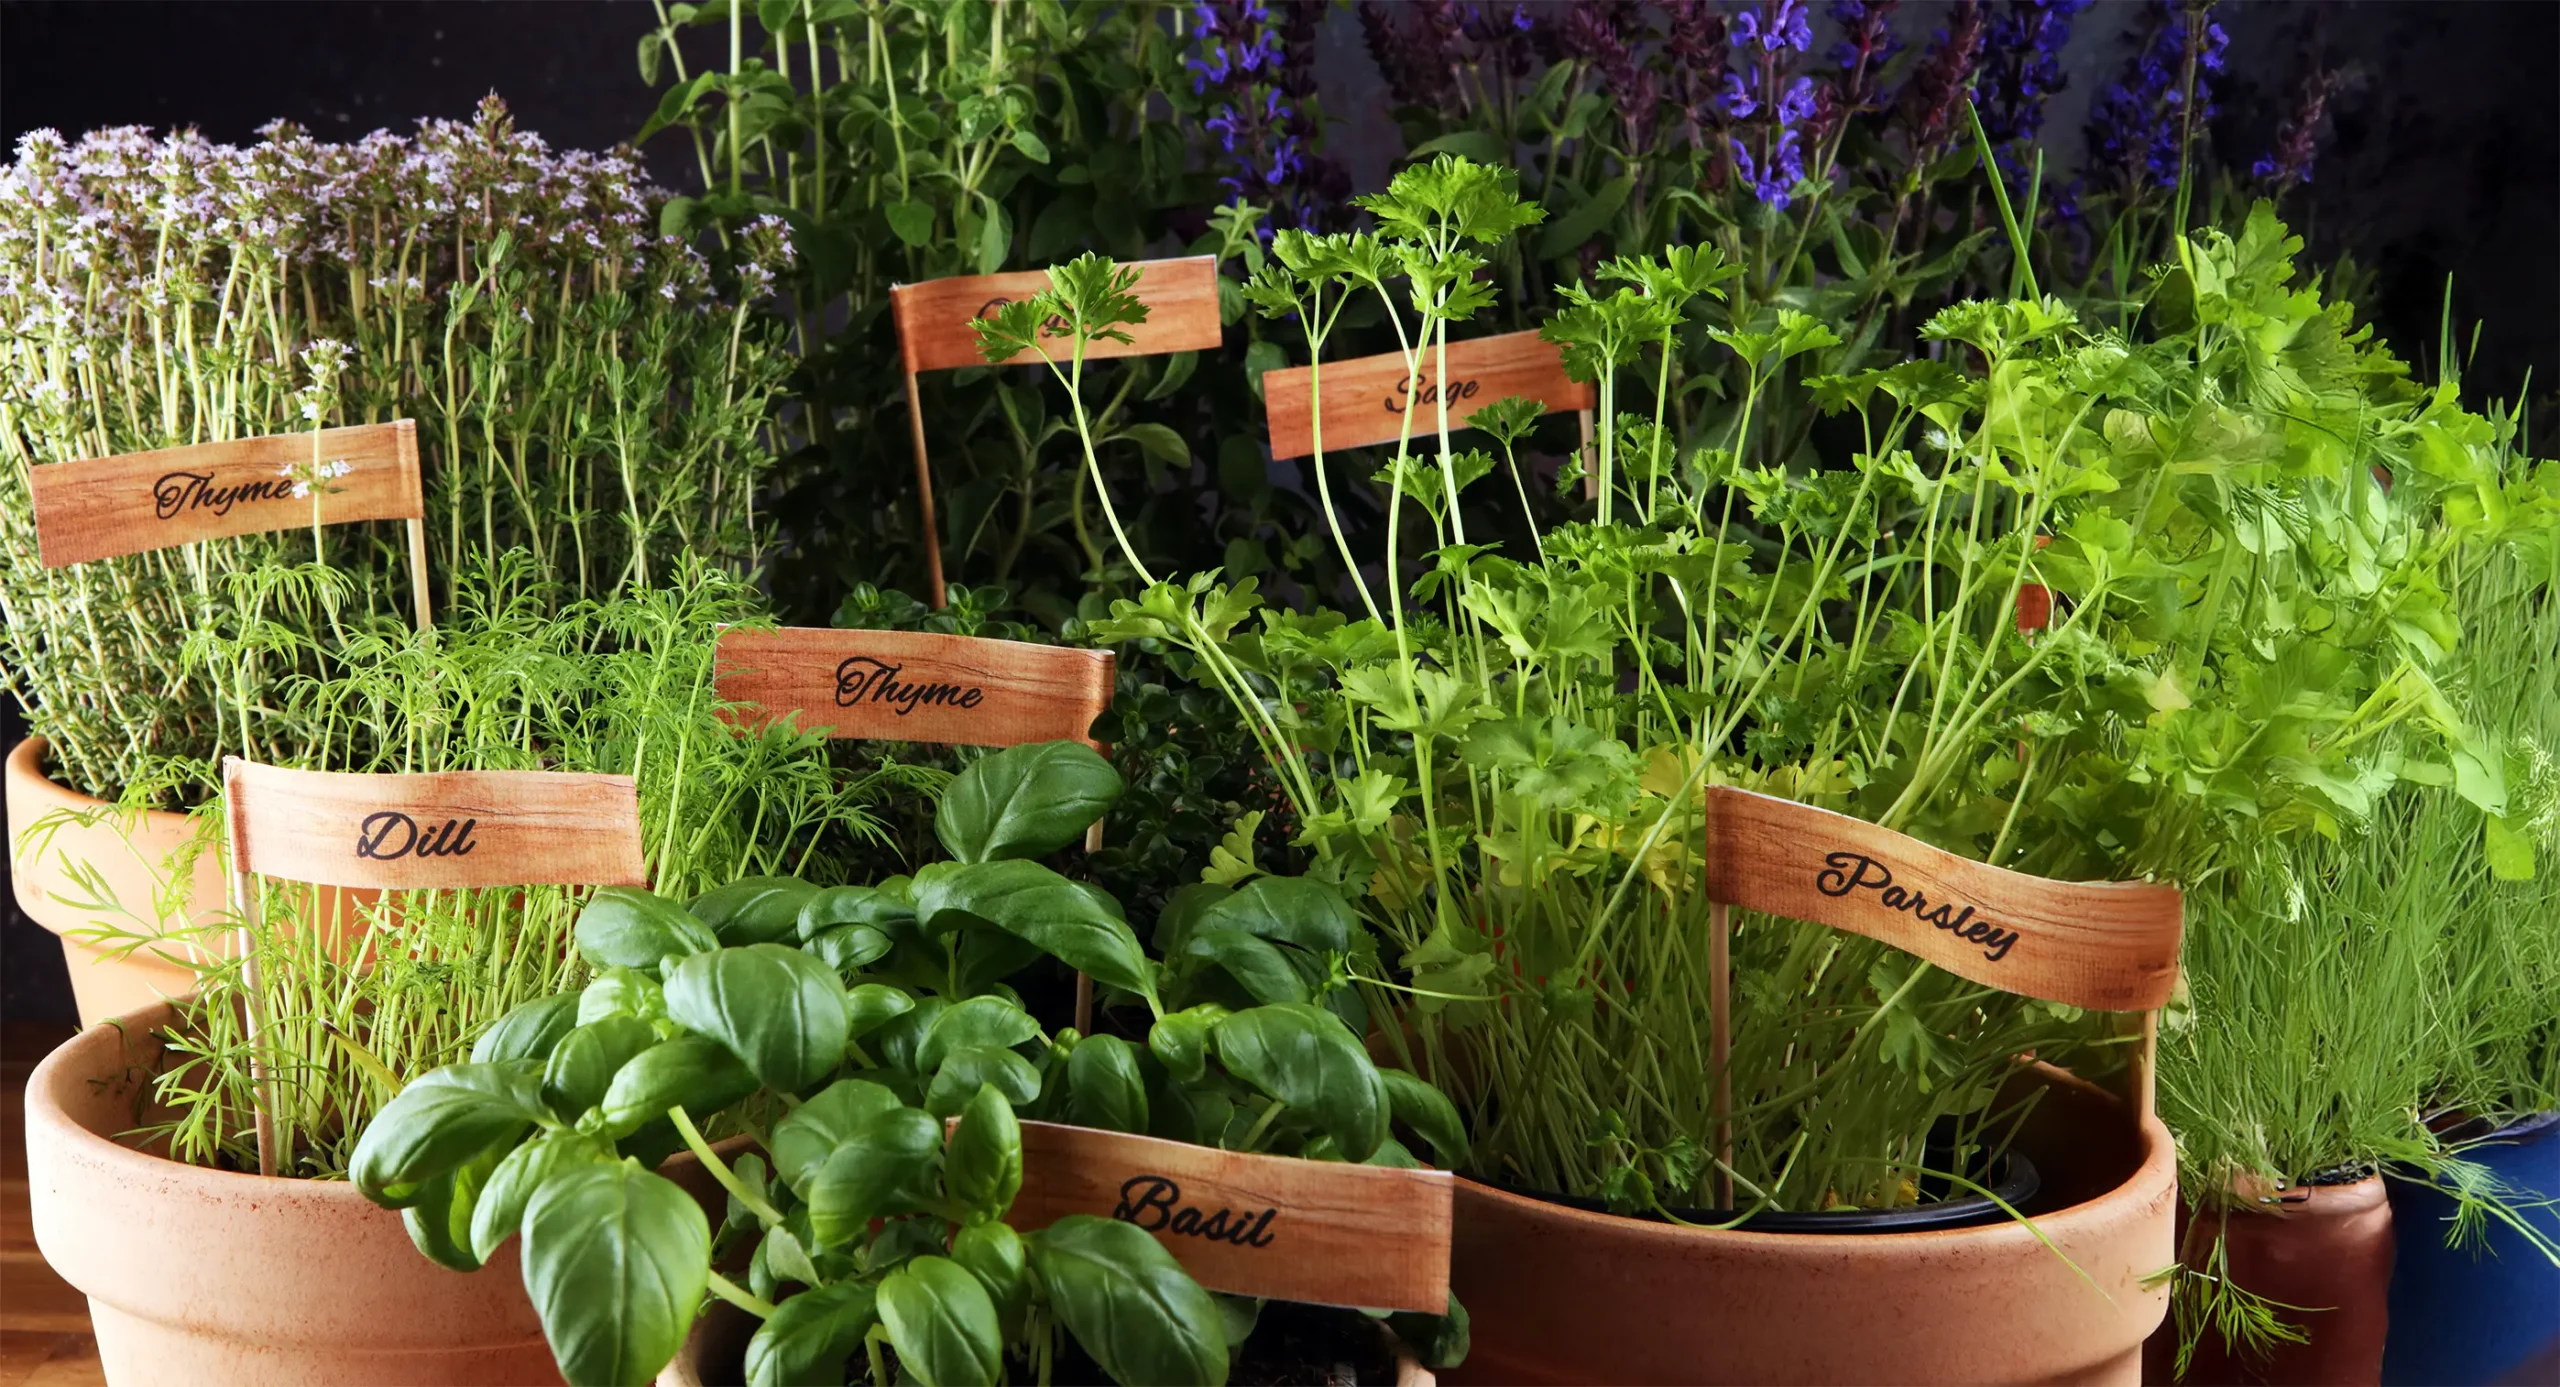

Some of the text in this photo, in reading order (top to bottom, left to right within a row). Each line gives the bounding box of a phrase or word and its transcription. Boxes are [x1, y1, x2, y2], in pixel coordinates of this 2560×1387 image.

[1384, 373, 1479, 413] Sage
[153, 471, 294, 520] Thyme
[835, 656, 984, 716] Thyme
[356, 811, 477, 860] Dill
[1816, 852, 2020, 962] Parsley
[1112, 1175, 1277, 1248] Basil
